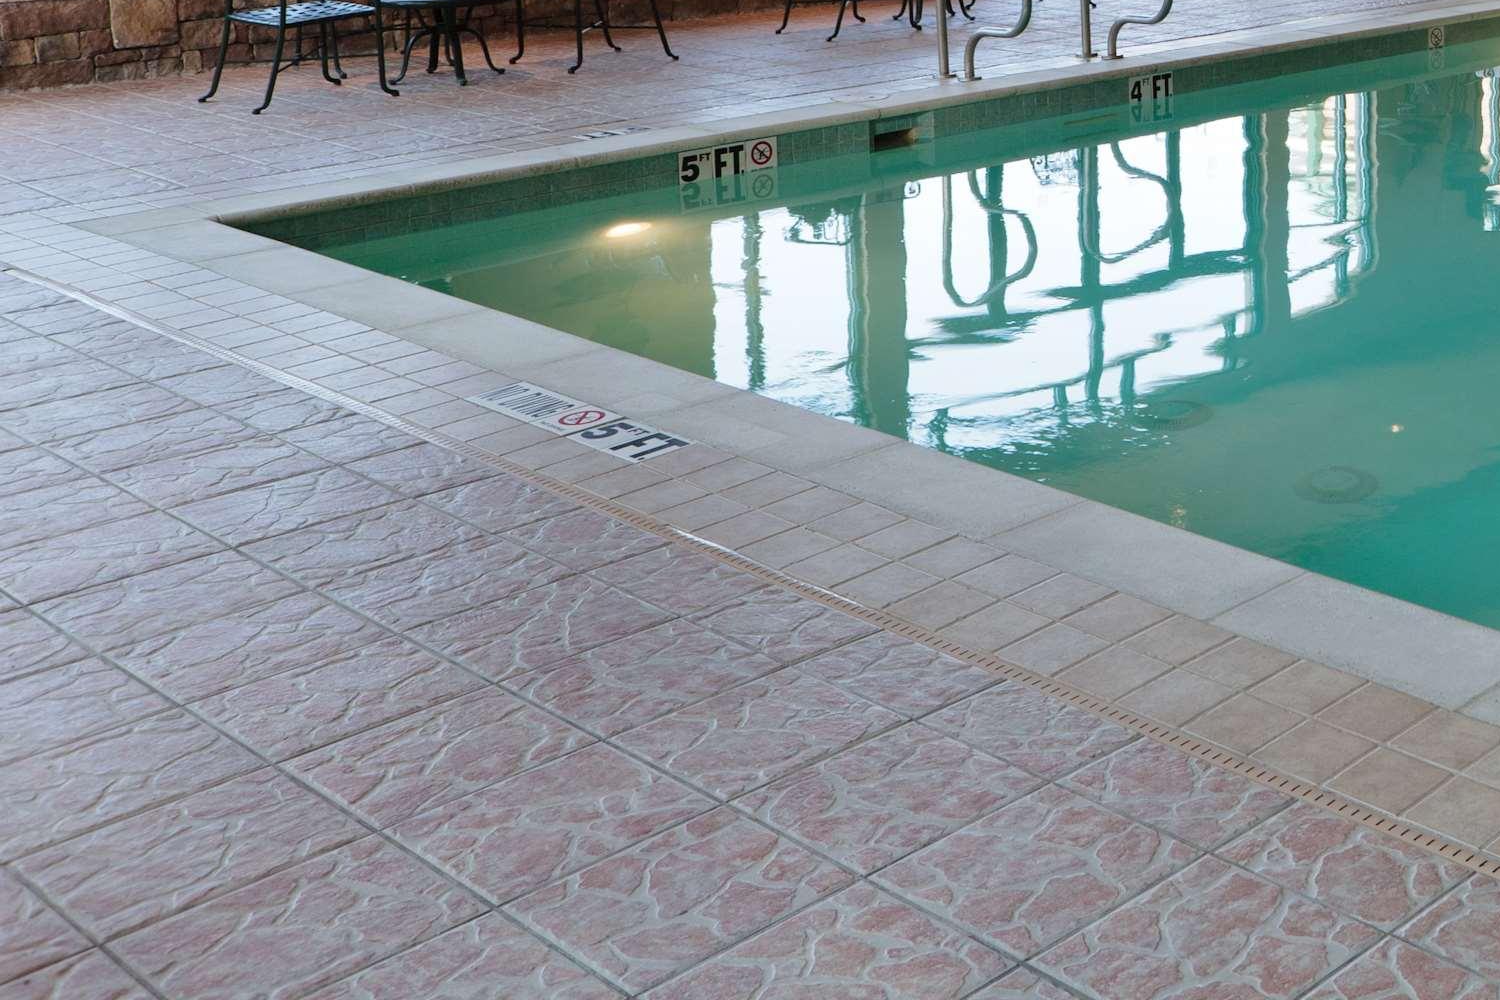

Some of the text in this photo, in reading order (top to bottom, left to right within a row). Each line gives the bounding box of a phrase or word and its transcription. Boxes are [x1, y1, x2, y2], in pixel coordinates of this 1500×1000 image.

[1131, 80, 1142, 102] 4
[681, 154, 700, 182] 5
[580, 421, 635, 439] 5
